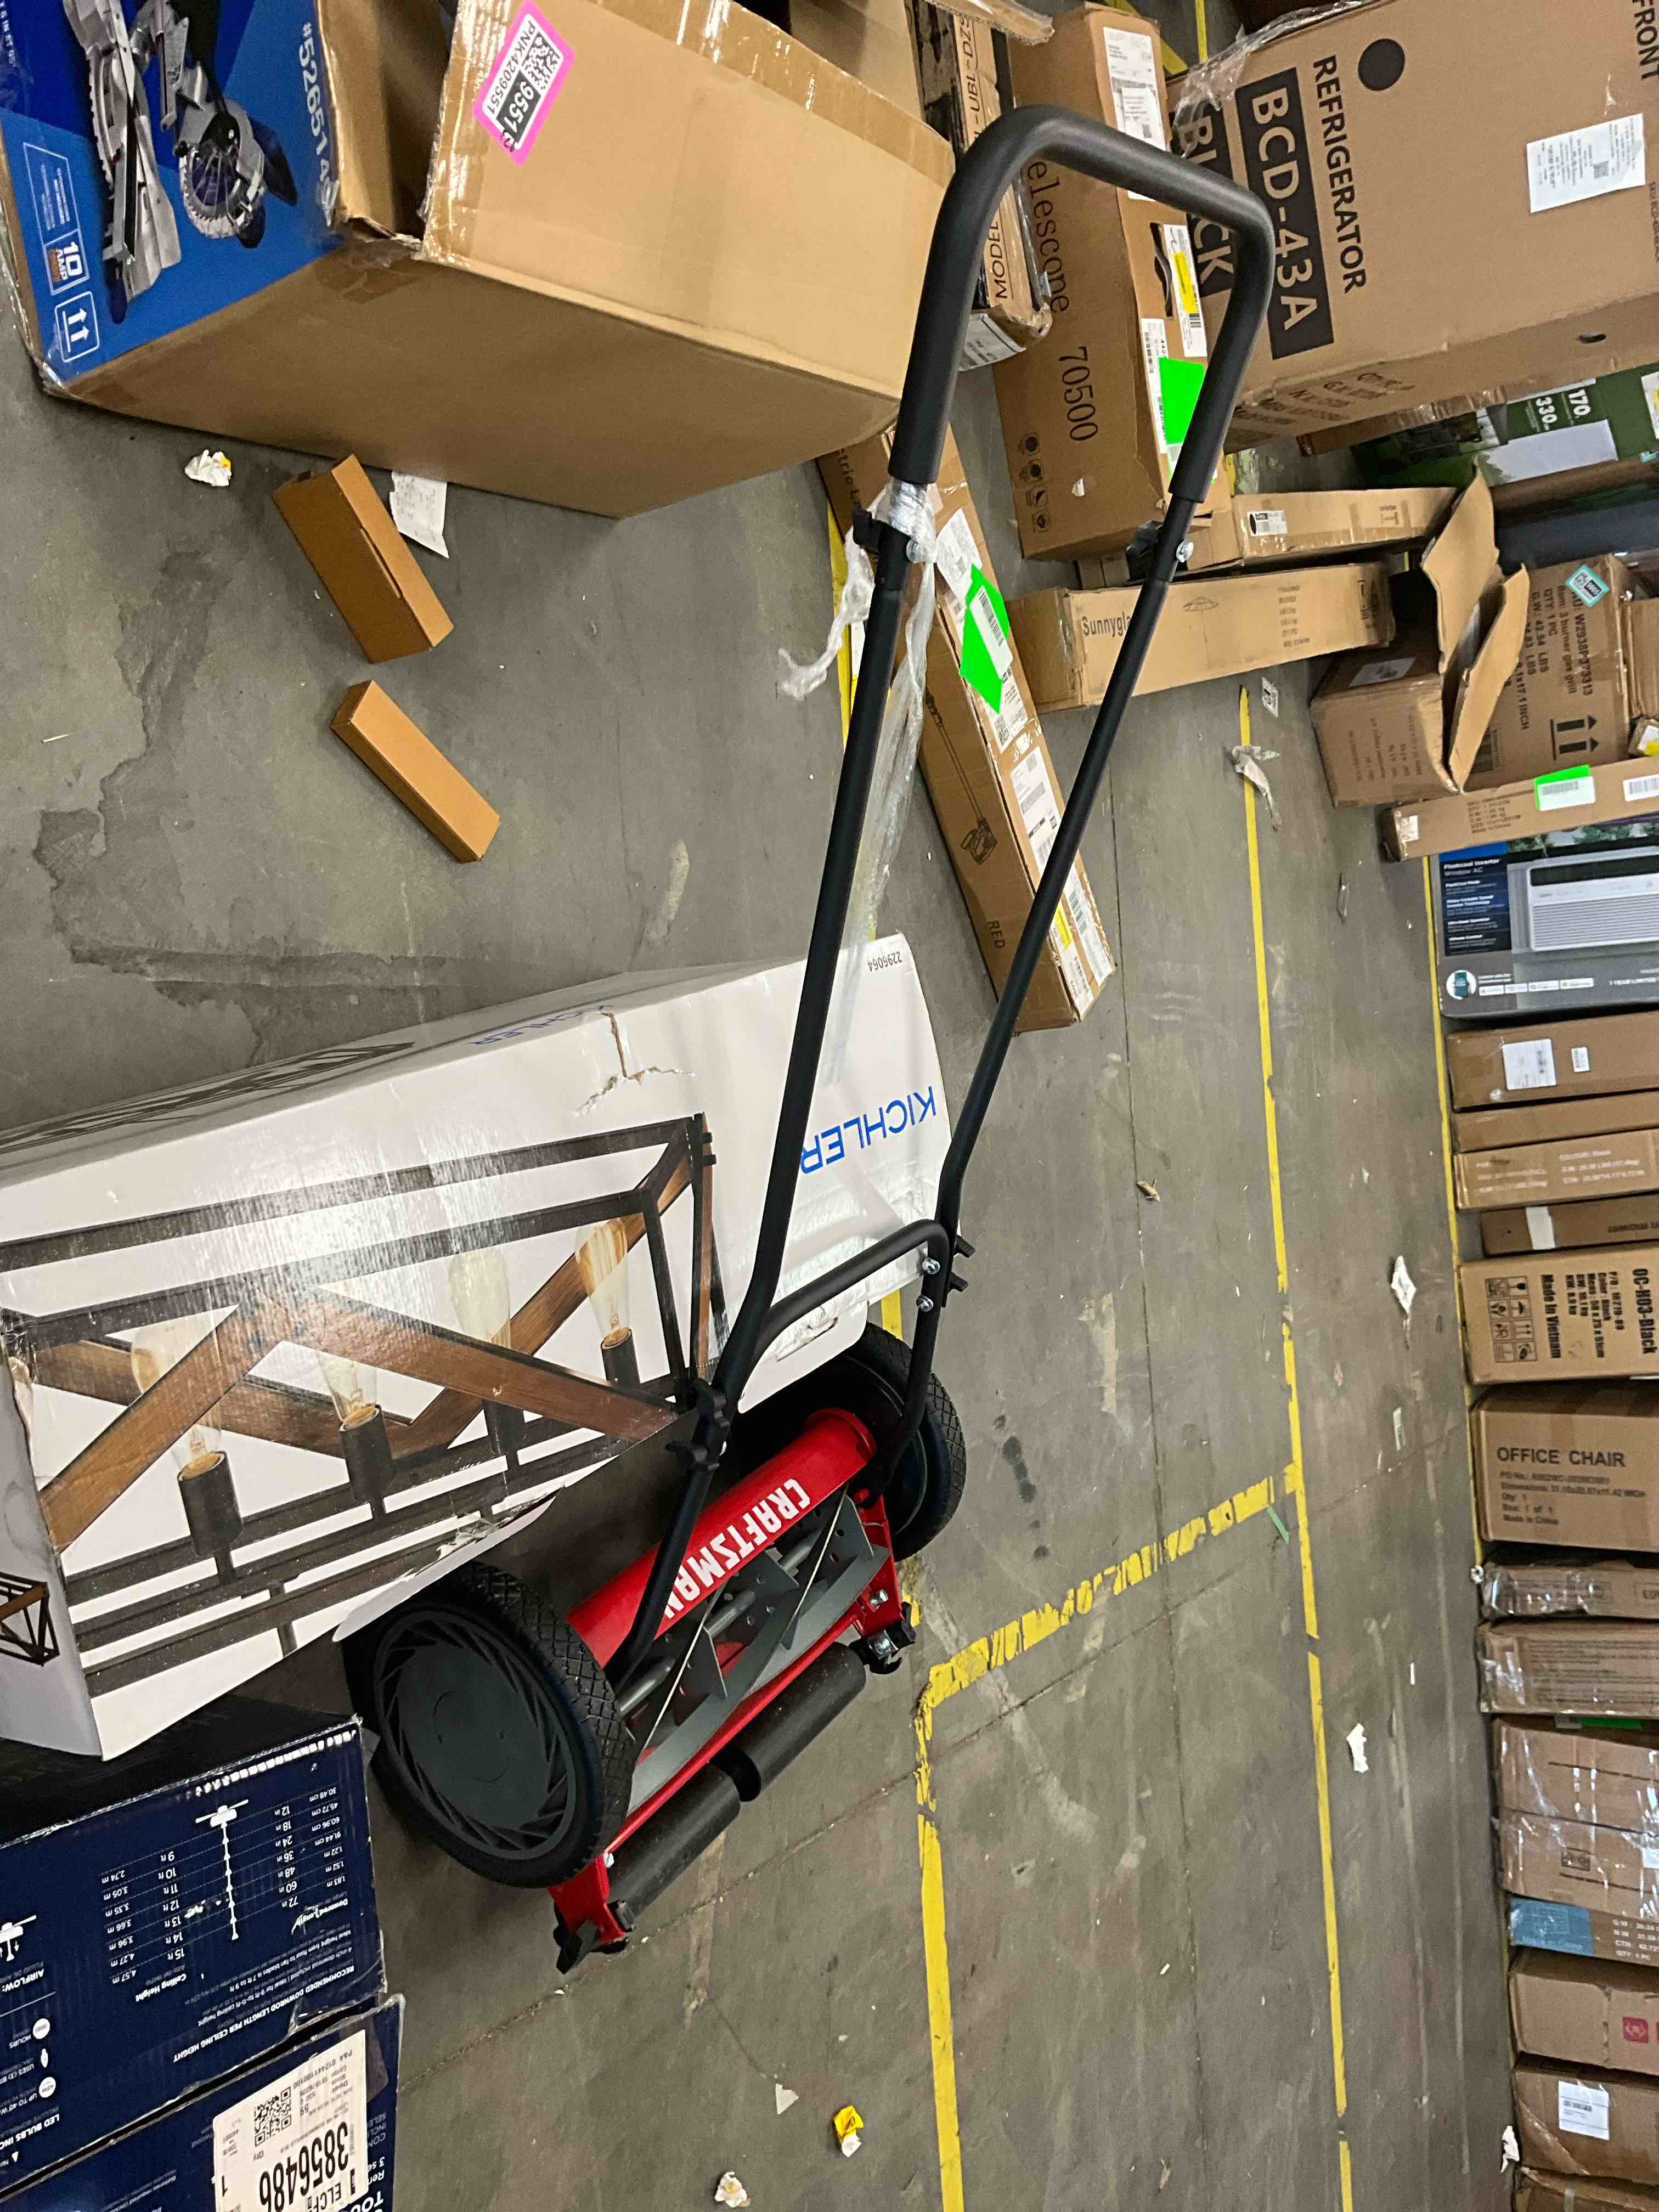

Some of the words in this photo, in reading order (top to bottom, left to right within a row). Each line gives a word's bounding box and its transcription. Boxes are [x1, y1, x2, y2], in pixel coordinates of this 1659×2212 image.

[504, 81, 534, 133] 9551
[1312, 54, 1367, 295] REFRIGERATOR
[1179, 116, 1234, 285] BLCK
[1251, 88, 1317, 330] BCD-43A
[56, 249, 68, 280] AMP
[63, 241, 82, 277] 10
[988, 221, 1008, 300] MODEL
[1058, 346, 1099, 442] 70500
[1536, 397, 1558, 424] 330
[1568, 390, 1591, 416] 170
[1548, 622, 1558, 636] PC
[987, 920, 1006, 949] RED
[867, 951, 902, 972] 2296064
[800, 1086, 936, 1174] KICHLER
[1497, 1447, 1560, 1464] OFFICE
[1569, 1450, 1627, 1467] CHAIR
[282, 1805, 290, 1815] 12
[283, 1821, 291, 1831] 18
[283, 1835, 292, 1847] 24
[168, 1852, 174, 1861] 9
[284, 1850, 294, 1861] 36
[166, 1868, 176, 1878] 10
[285, 1867, 295, 1877] 48
[171, 1883, 178, 1894] 11
[286, 1881, 297, 1893] 60
[170, 1899, 179, 1911] 12
[289, 1896, 298, 1908] 72
[318, 1898, 348, 1917] Downrod
[165, 1920, 170, 1928] ft
[172, 1916, 181, 1927] 13
[173, 1931, 183, 1944] 14
[174, 1948, 184, 1960] 15
[2, 1968, 44, 1992] AIRFLOW:
[161, 1973, 187, 1989] Ceiling
[305, 1966, 354, 1993] RECOMMENDED
[136, 1985, 160, 2002] Height
[271, 1989, 303, 2011] DOWNROD
[244, 2007, 269, 2025] LENGTH
[229, 2021, 242, 2033] PER
[9, 2034, 31, 2049] HOURS
[200, 2029, 228, 2046] CEILING
[173, 2044, 199, 2062] HEIGHT
[18, 2063, 34, 2076] USES
[19, 2097, 27, 2107] TO
[29, 2092, 37, 2103] UP
[44, 2114, 60, 2127] LED
[15, 2122, 42, 2142] BULBS
[259, 2122, 348, 2212] 3856486
[379, 2157, 385, 2167] 3
[221, 2175, 228, 2198] 1
